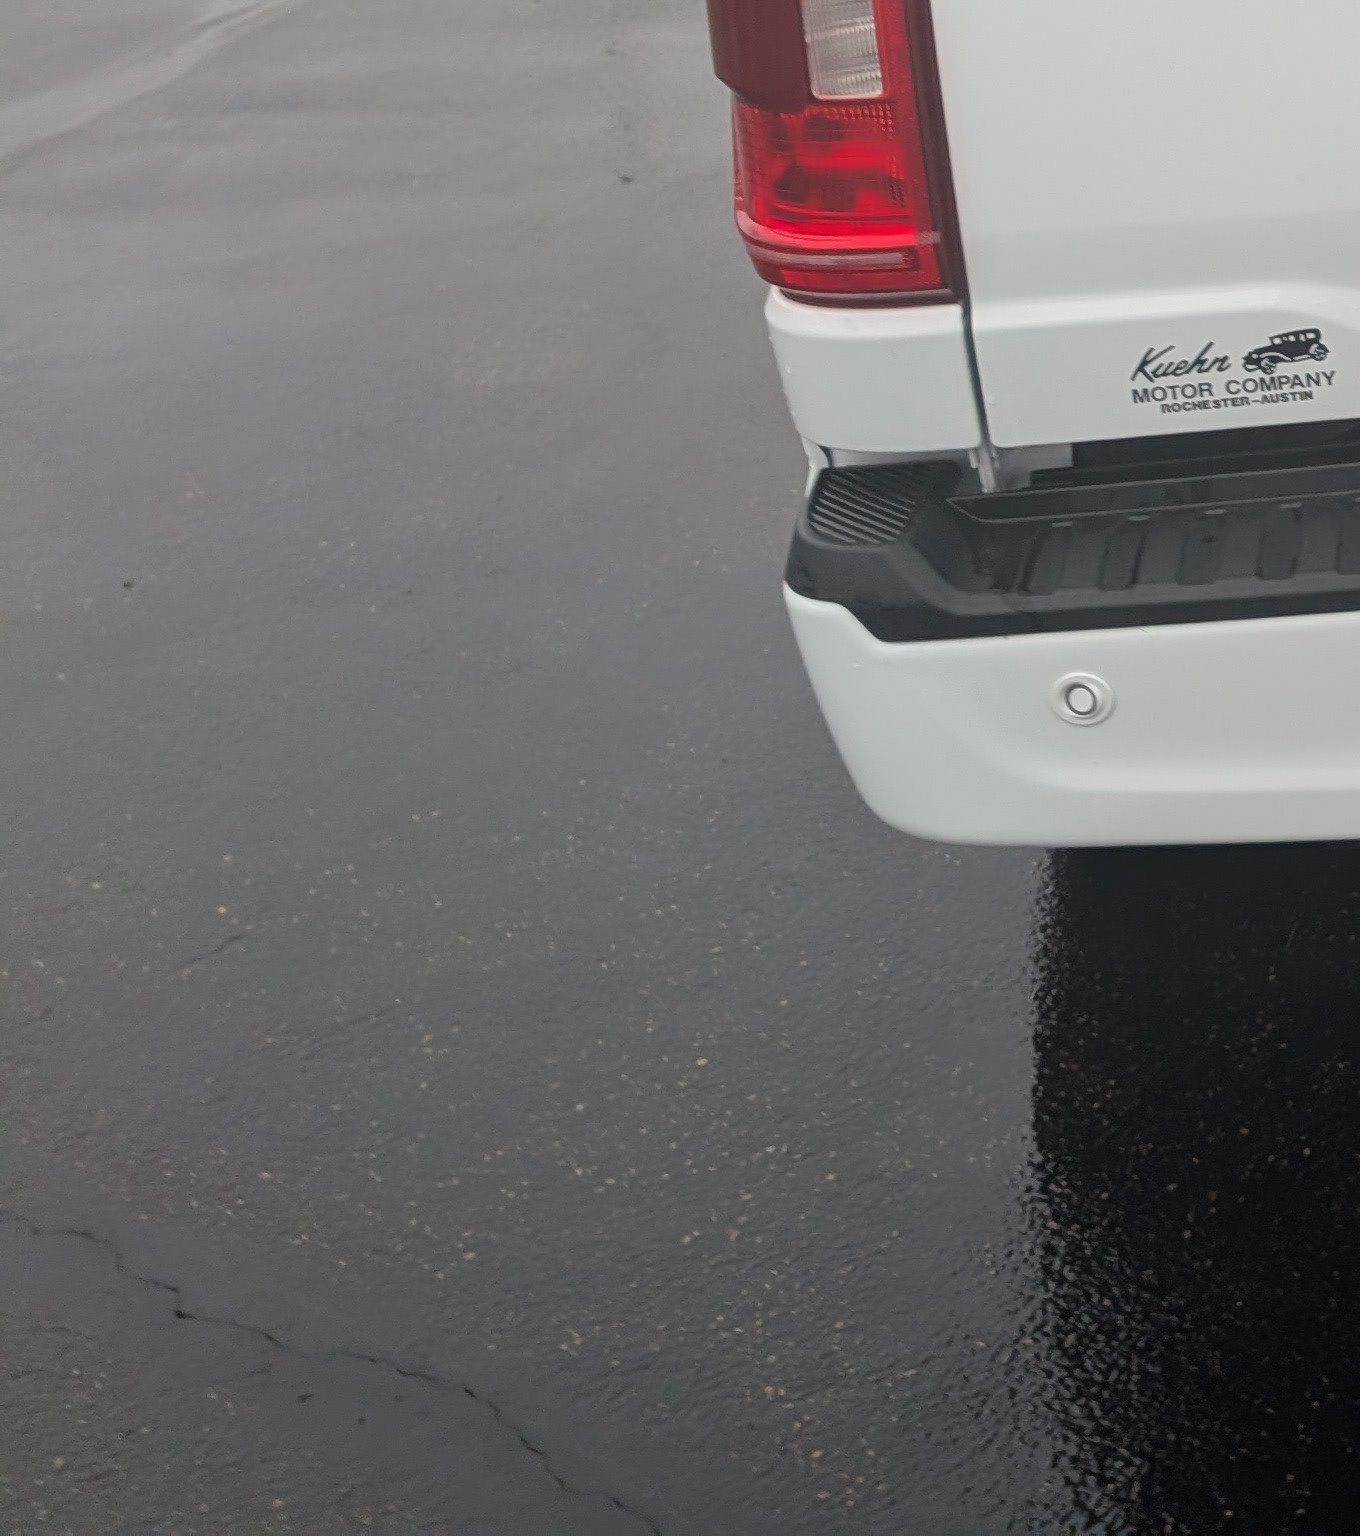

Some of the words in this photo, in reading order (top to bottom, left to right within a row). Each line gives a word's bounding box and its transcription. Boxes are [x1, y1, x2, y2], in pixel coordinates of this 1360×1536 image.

[1130, 341, 1232, 383] Kuehn
[1131, 382, 1214, 404] MOTOR
[1225, 370, 1336, 395] COMPANY
